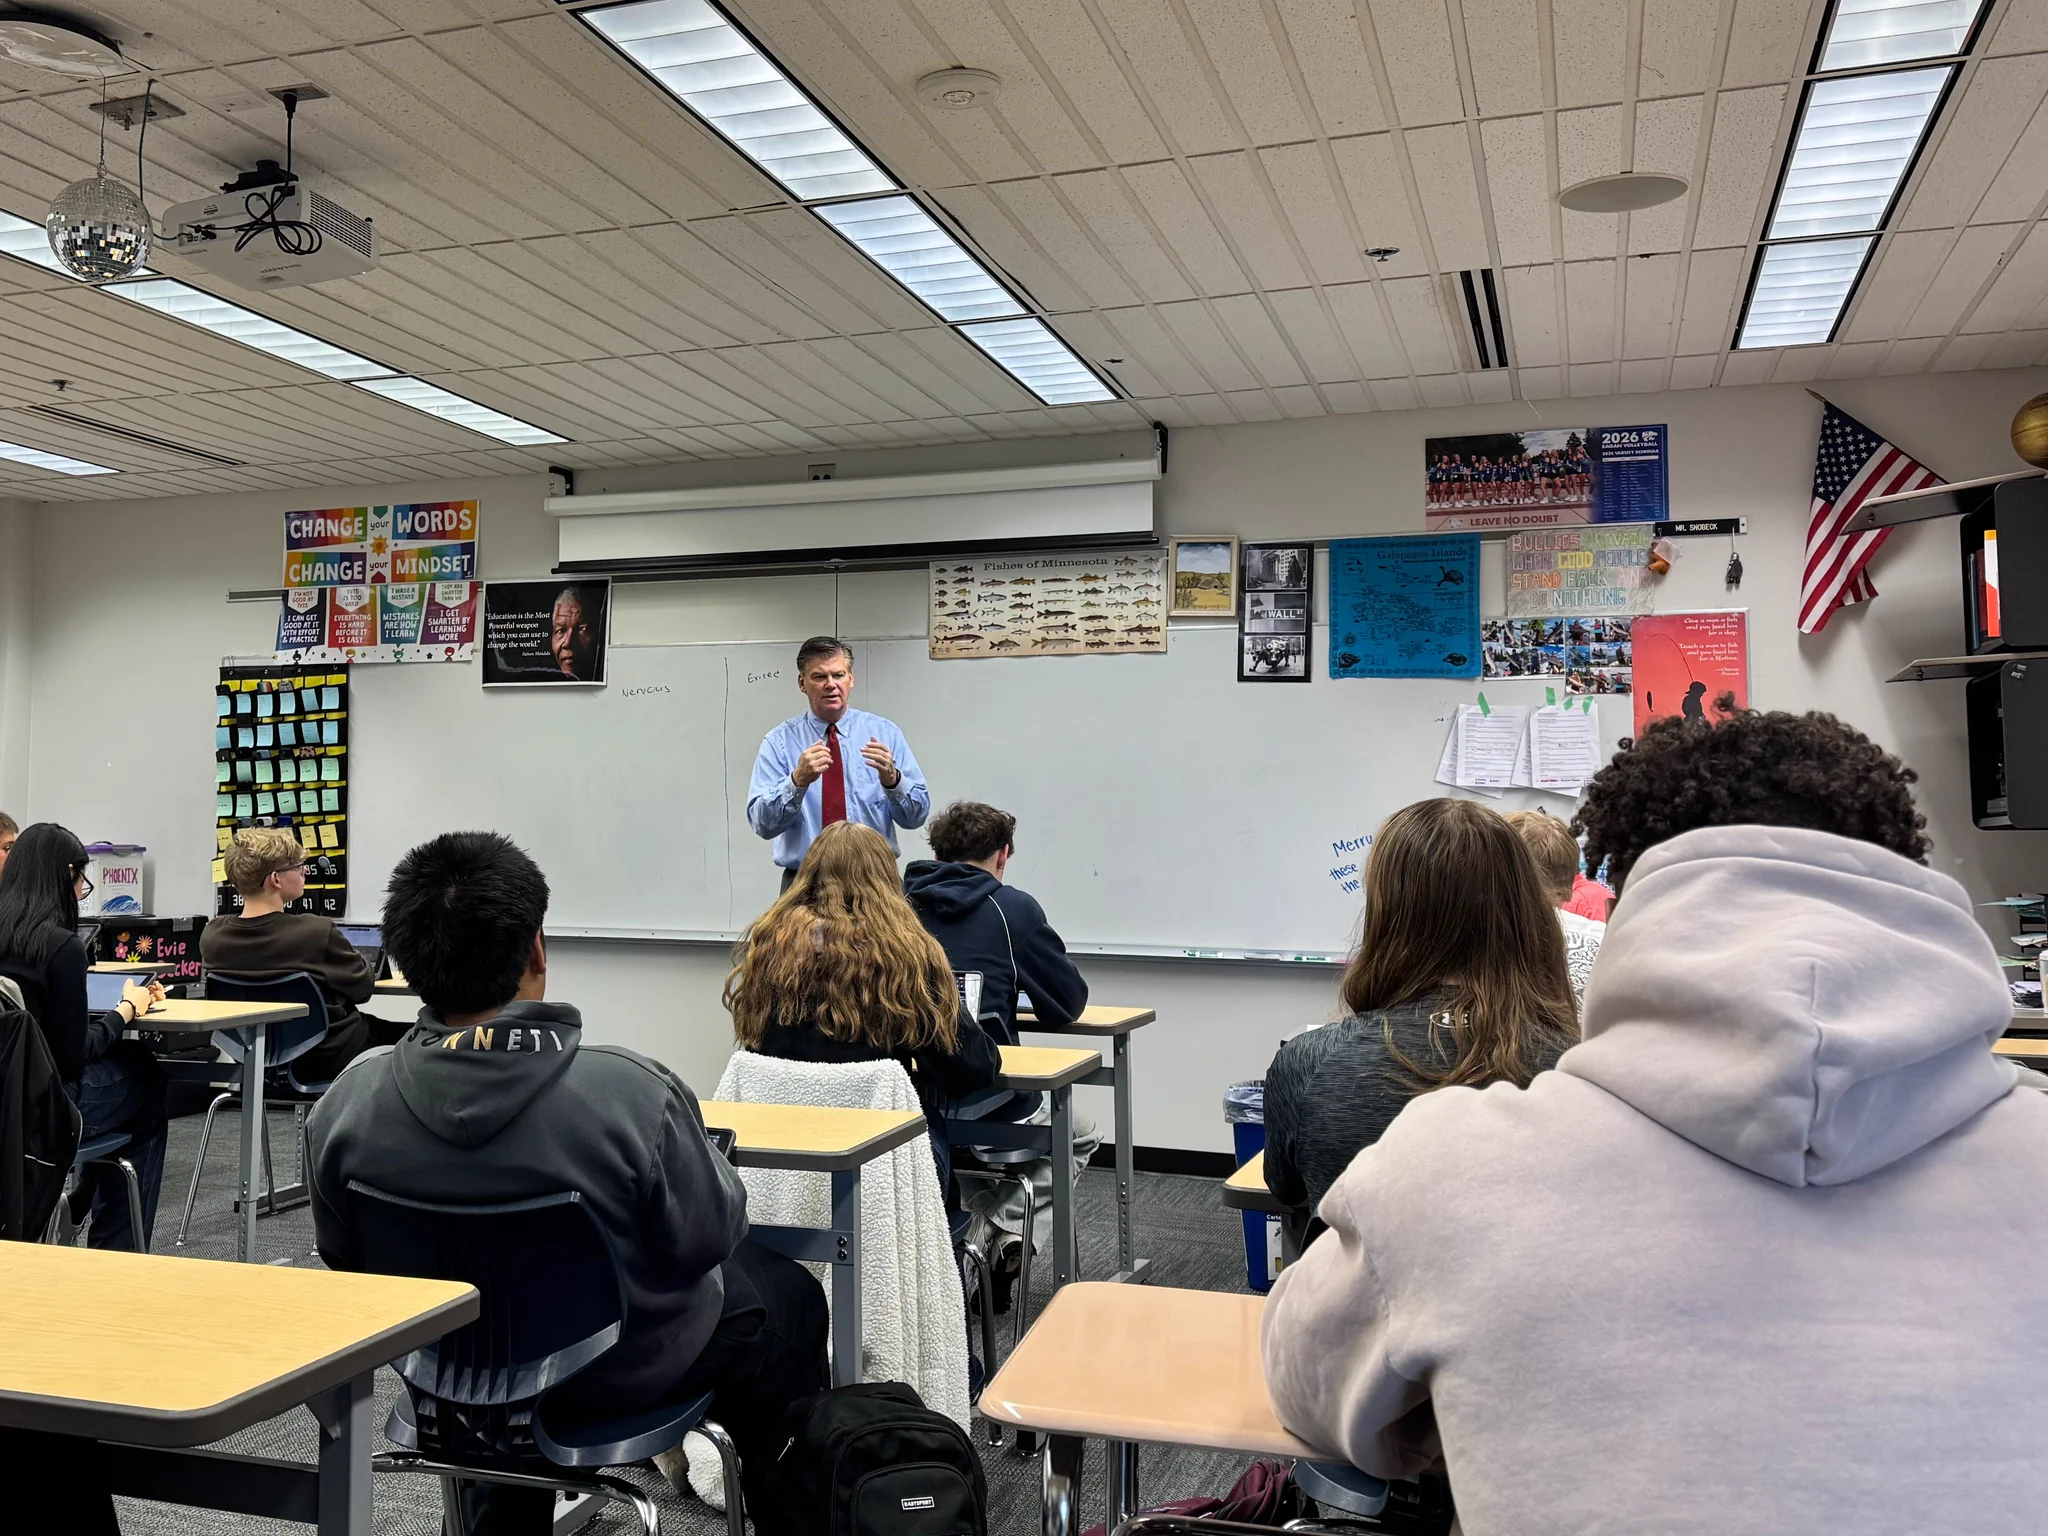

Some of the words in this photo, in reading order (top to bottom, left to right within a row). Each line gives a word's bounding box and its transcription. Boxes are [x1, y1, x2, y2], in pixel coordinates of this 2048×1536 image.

[1602, 432, 1639, 444] 2026
[290, 517, 363, 539] CHANGE
[370, 520, 389, 531] your
[397, 509, 472, 533] WORDS
[1470, 518, 1500, 526] LEAVE
[1503, 517, 1520, 525] NO
[1523, 515, 1559, 524] DOUBT
[1512, 533, 1580, 551] BULLIES
[1583, 530, 1647, 548] PREVAIL
[1432, 547, 1466, 557] Islands
[984, 562, 1022, 570] Fishes
[1042, 558, 1108, 568] Minnesota
[1512, 552, 1554, 570] WHEN
[1558, 551, 1594, 569] GOOD
[1596, 549, 1646, 567] PEOPLE
[289, 561, 363, 582] CHANGE
[370, 562, 388, 571] your
[396, 554, 470, 575] MINDSET
[1512, 571, 1561, 590] STAND
[1566, 568, 1606, 588] BACK
[1616, 567, 1652, 586] AND
[1530, 590, 1547, 608] DO
[1552, 587, 1626, 608] NOTHING
[334, 613, 371, 621] EVERYTHING
[383, 612, 419, 621] MISTAKES
[446, 609, 459, 617] GET
[1268, 610, 1296, 618] WALL
[428, 617, 461, 625] SMARTER
[462, 616, 471, 624] BY
[489, 622, 515, 630] Powerful
[430, 625, 467, 633] LEARNING
[487, 642, 507, 650] change
[1728, 642, 1738, 650] fish
[622, 685, 671, 697] Nervous
[103, 867, 138, 884] PHOENIX
[1329, 864, 1358, 880] these
[1341, 880, 1360, 894] the
[232, 895, 244, 906] 38
[303, 899, 313, 909] 41
[324, 899, 336, 910] 42
[157, 938, 186, 958] Evie
[158, 960, 201, 979] cker
